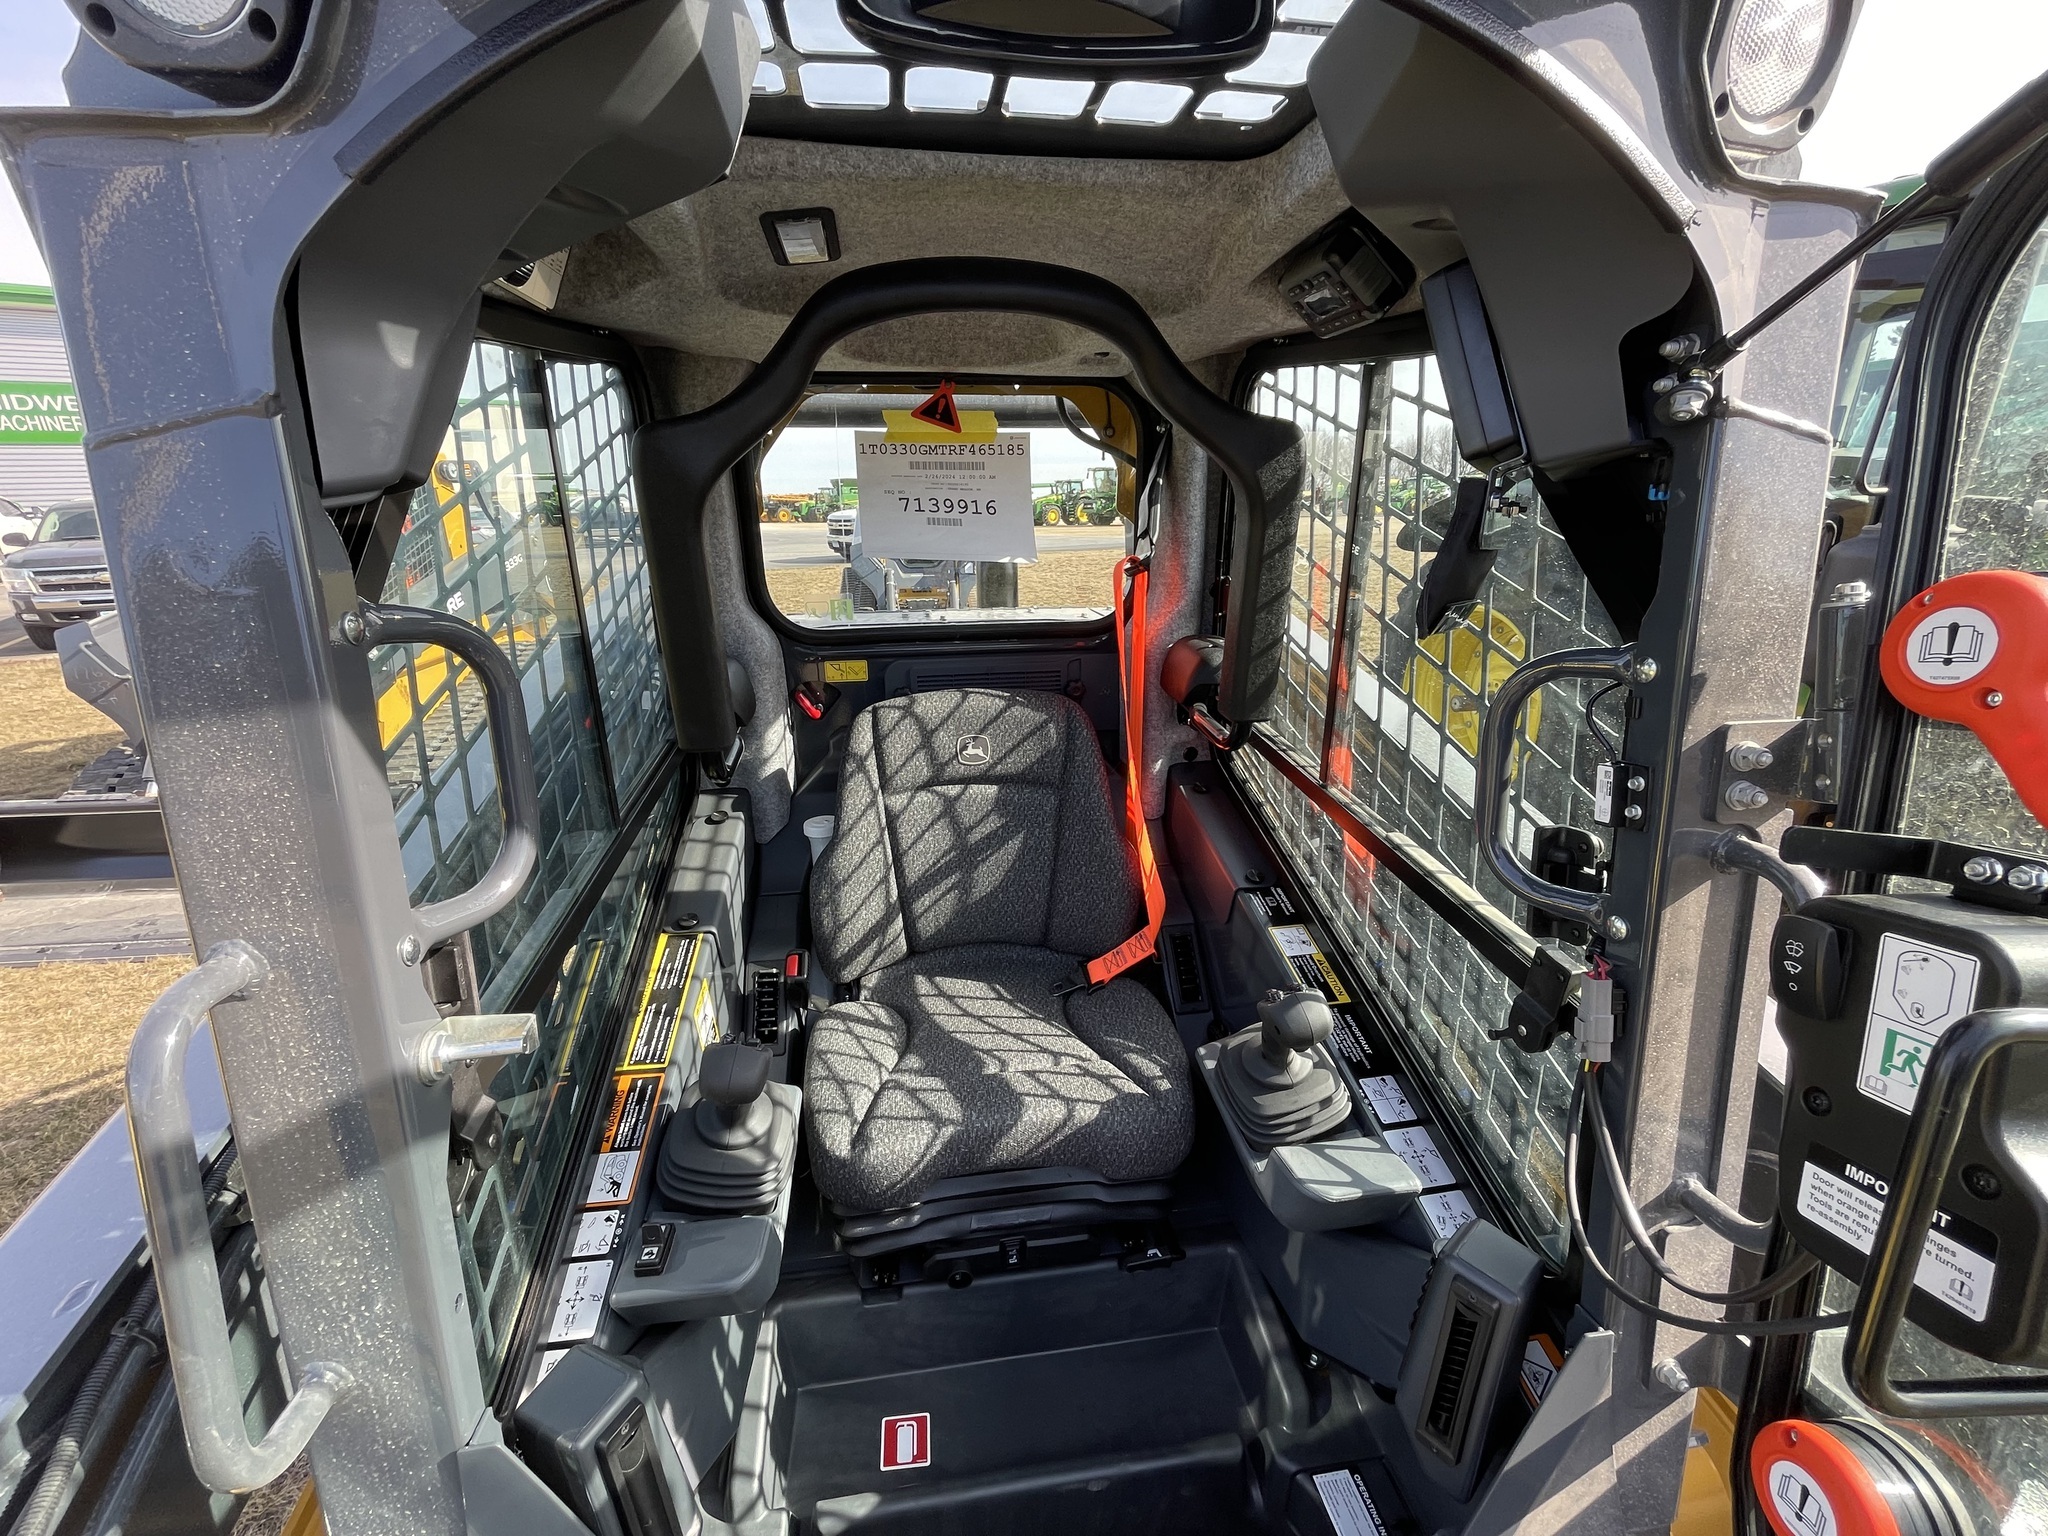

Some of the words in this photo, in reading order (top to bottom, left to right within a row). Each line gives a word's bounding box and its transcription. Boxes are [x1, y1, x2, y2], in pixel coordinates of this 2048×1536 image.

[859, 443, 1025, 456] 1T0330GMTRF465185
[898, 497, 997, 516] 7139916
[504, 553, 523, 572] 333G
[1321, 963, 1344, 996] CAUTION
[1345, 1014, 1372, 1054] IMPORTANT
[606, 1090, 625, 1133] WARNING
[1812, 1172, 1835, 1189] Door
[1836, 1186, 1853, 1200] will
[1806, 1203, 1864, 1242] re-assembly.
[1809, 1191, 1833, 1211] Tools
[1835, 1208, 1850, 1221] are
[1810, 1183, 1834, 1201] when
[1836, 1198, 1870, 1221] orange
[1934, 1253, 1975, 1282] turned.
[1353, 1474, 1382, 1525] OPERATING
